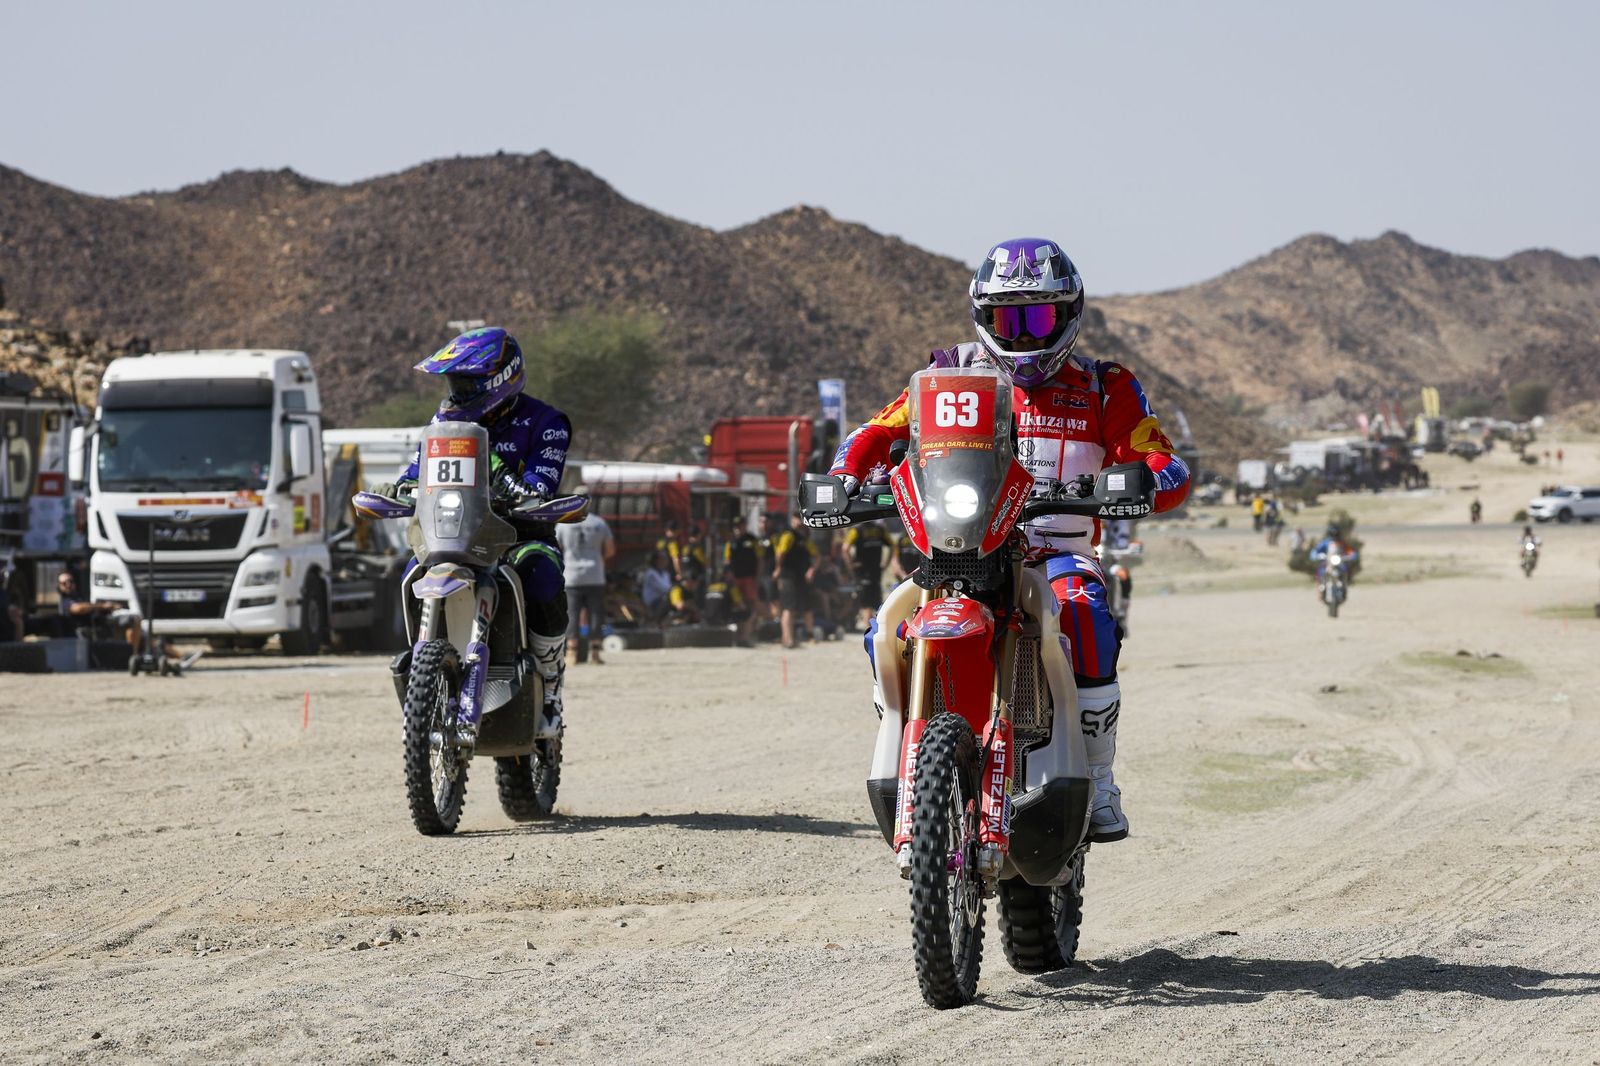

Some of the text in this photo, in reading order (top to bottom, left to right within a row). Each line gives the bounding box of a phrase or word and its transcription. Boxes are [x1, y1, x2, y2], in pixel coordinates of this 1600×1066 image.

[484, 355, 521, 390] 100%
[935, 391, 979, 427] 63
[1020, 412, 1087, 431] Ikuzawa
[437, 460, 463, 482] 81
[1020, 460, 1056, 469] REATIONS
[1010, 481, 1032, 518] HAWKER
[1098, 504, 1151, 516] ACERBIS
[803, 515, 851, 528] ACERBIS
[988, 739, 1006, 833] METZELER
